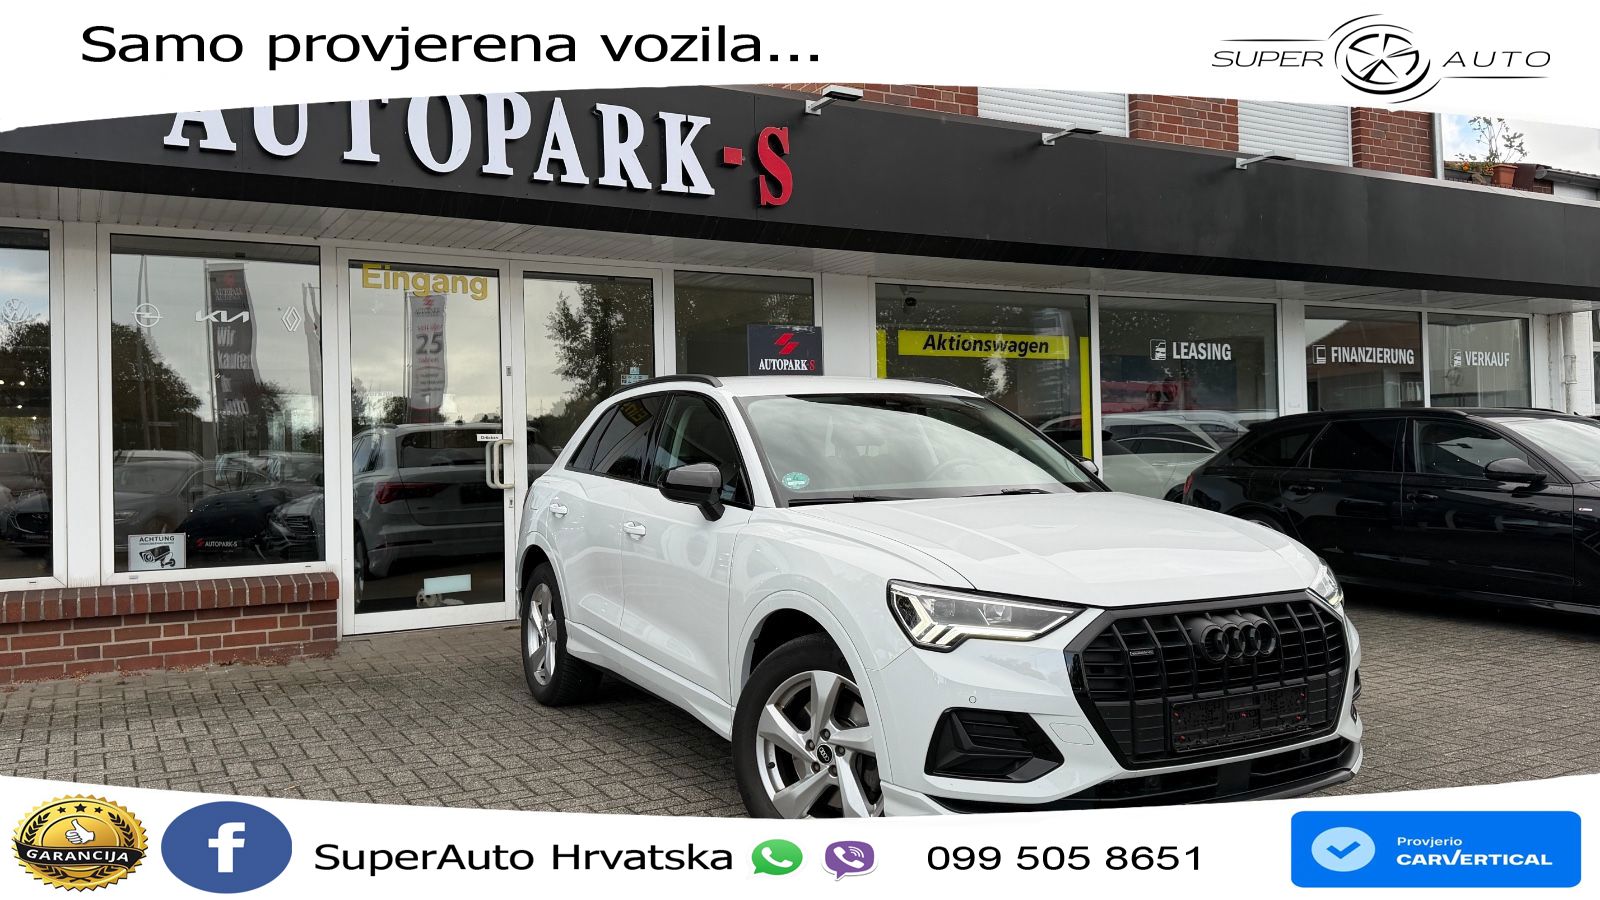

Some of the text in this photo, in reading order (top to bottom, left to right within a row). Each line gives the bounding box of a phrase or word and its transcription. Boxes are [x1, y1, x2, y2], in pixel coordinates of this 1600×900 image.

[362, 263, 488, 300] Eingang
[416, 331, 443, 354] 25
[923, 334, 1049, 357] Aktionswagen
[1172, 341, 1232, 361] LEASING
[1331, 346, 1415, 365] FINANZIERUNG
[1465, 351, 1510, 367] VERKAUF
